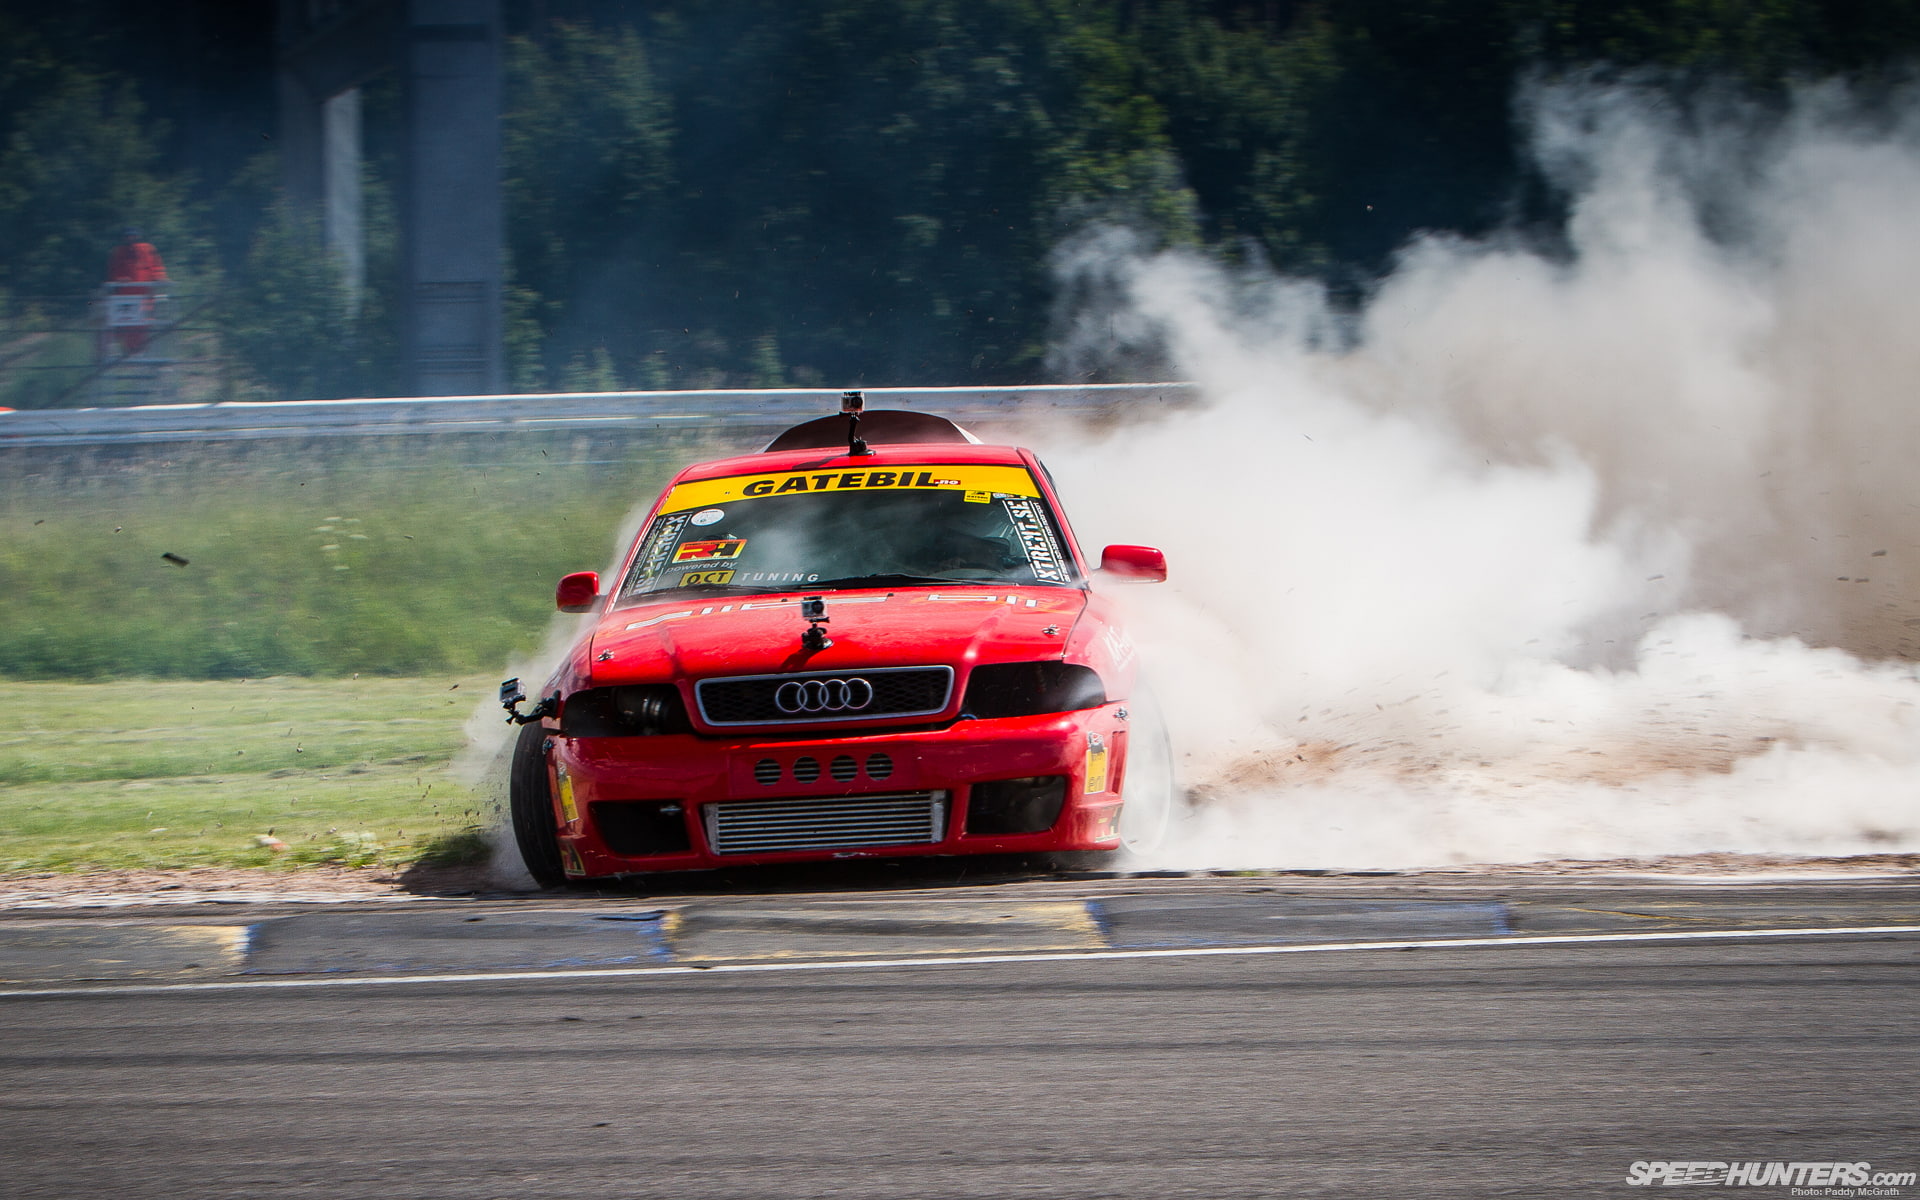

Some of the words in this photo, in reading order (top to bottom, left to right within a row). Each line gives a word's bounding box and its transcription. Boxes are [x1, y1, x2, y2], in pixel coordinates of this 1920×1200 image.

[664, 561, 720, 575] powered
[721, 561, 738, 570] by
[741, 572, 820, 583] TUNING
